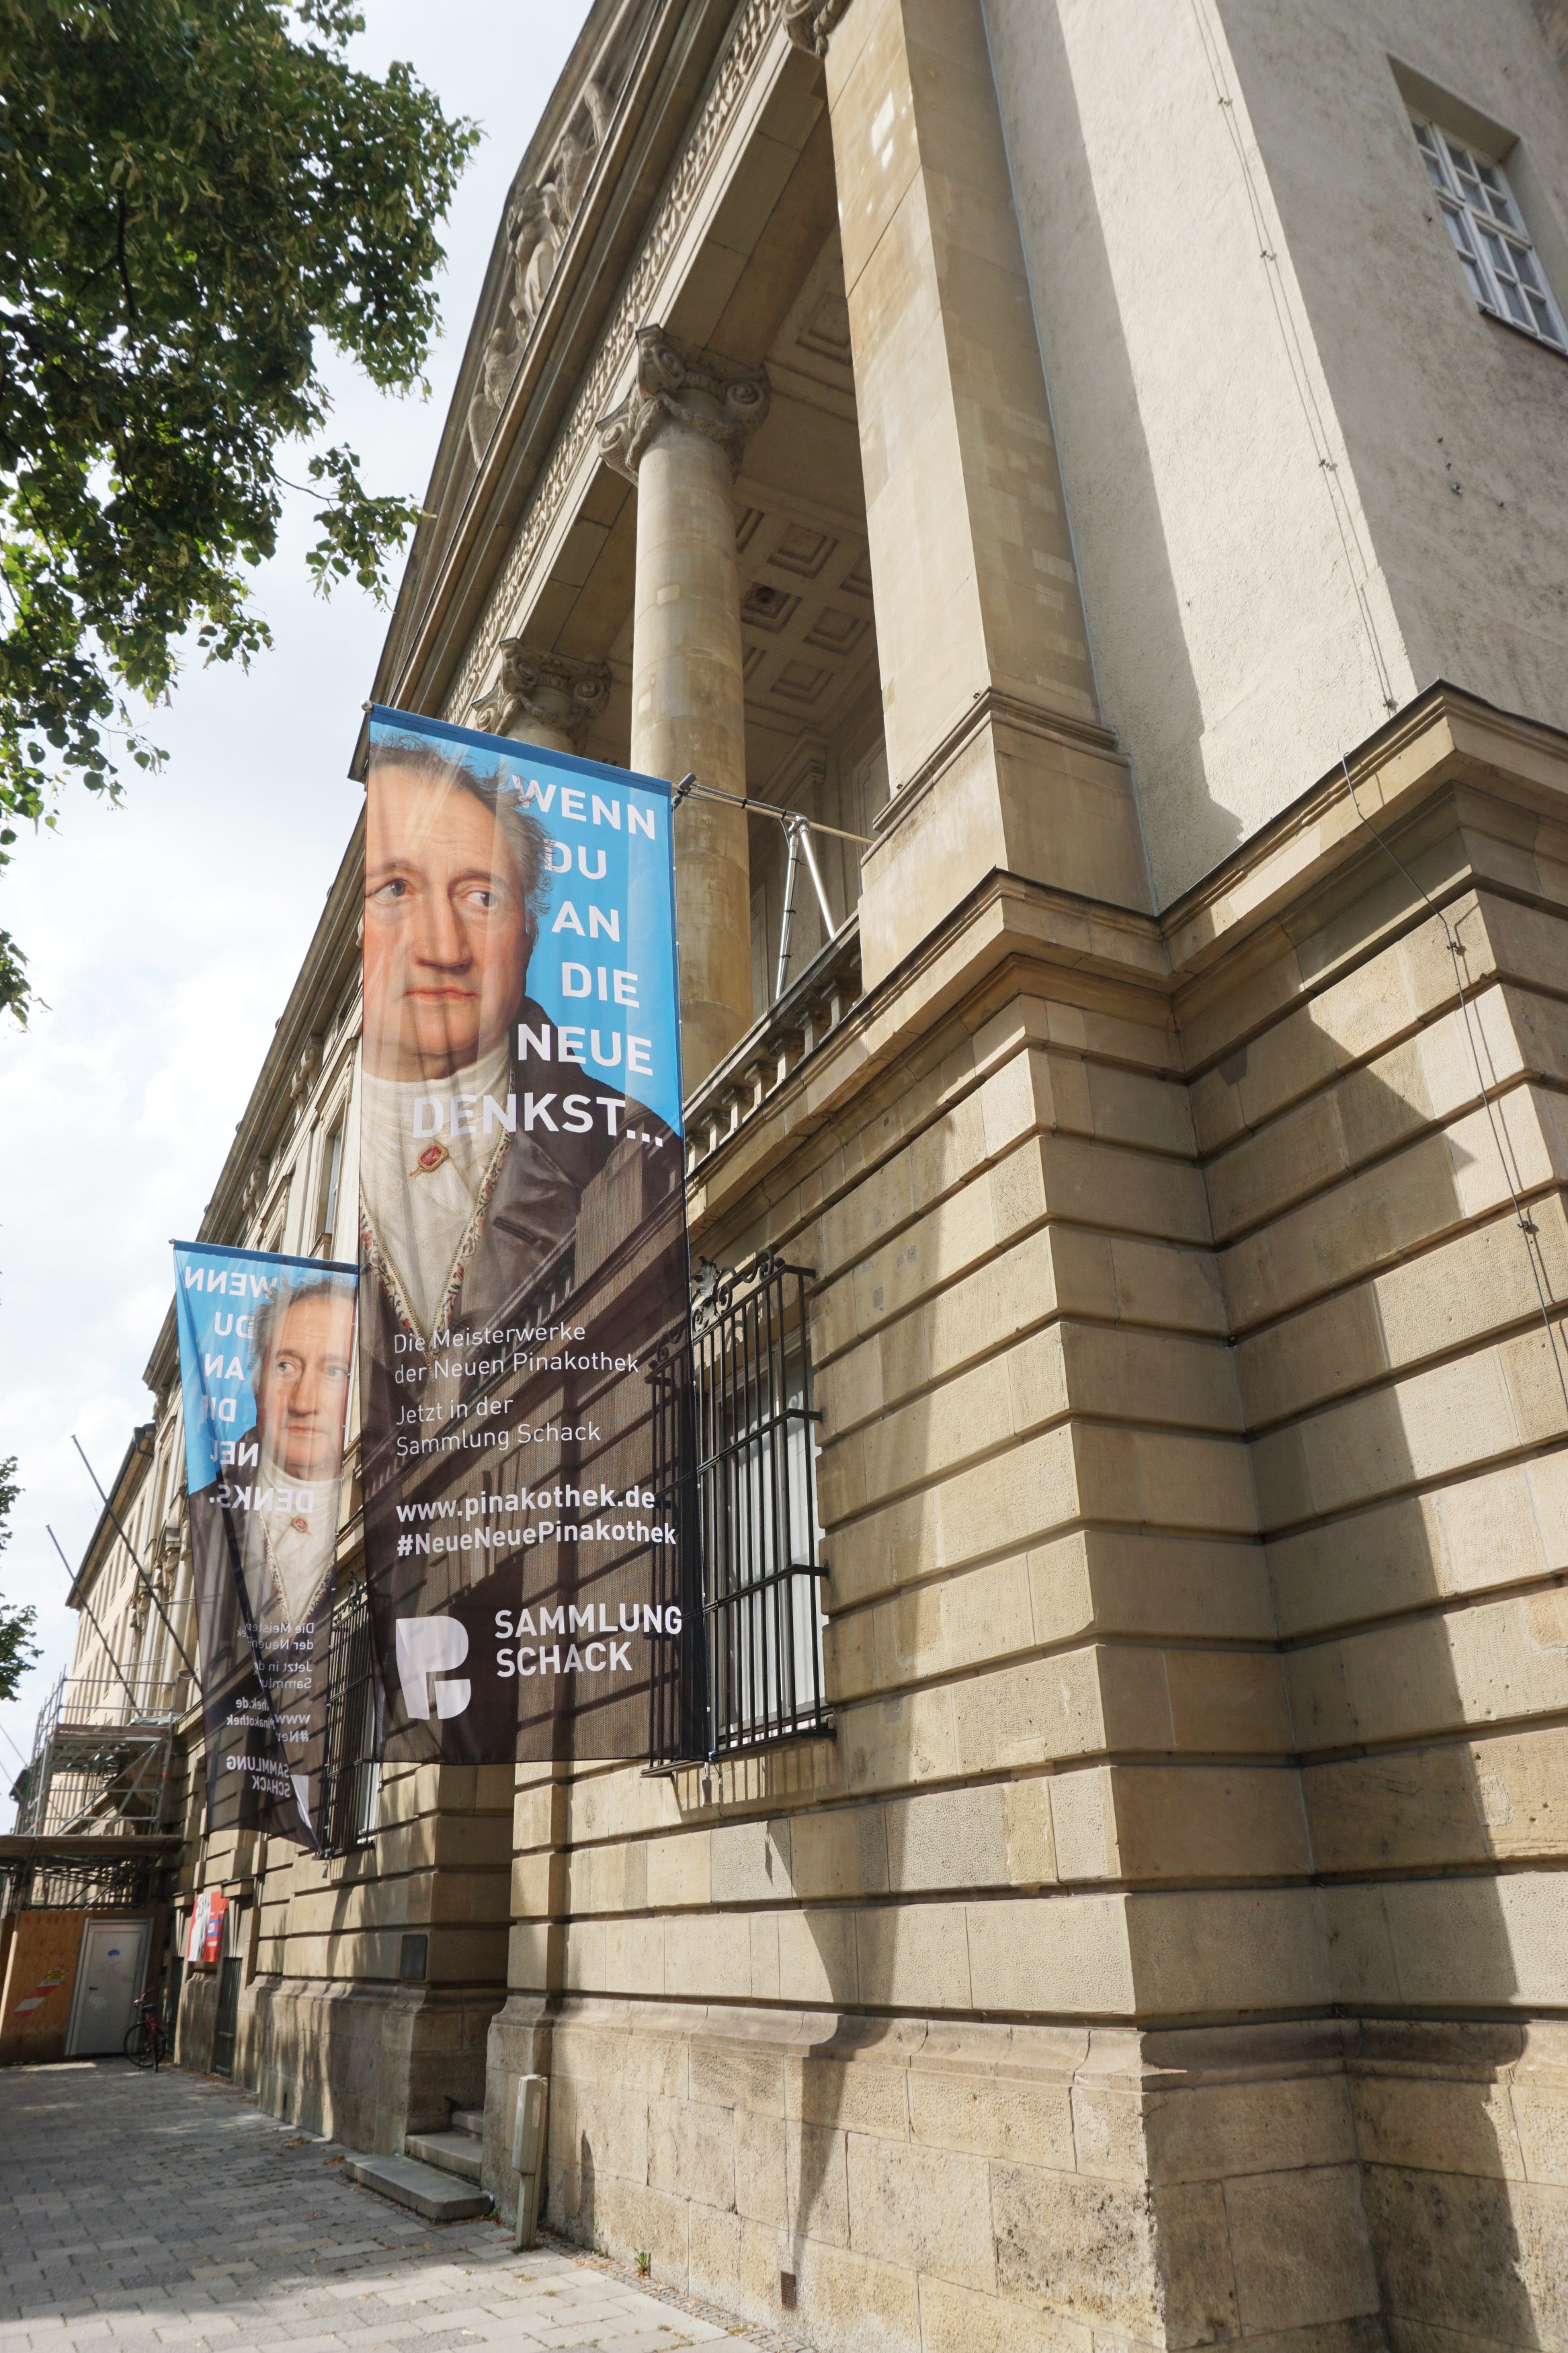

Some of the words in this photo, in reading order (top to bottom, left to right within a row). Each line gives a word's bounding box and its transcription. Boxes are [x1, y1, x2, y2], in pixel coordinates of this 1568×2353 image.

[513, 774, 656, 840] WENN
[544, 838, 608, 879] DU
[551, 901, 620, 943] AN
[562, 961, 640, 1008] DIE
[518, 1023, 654, 1076] NEUE
[413, 1092, 663, 1147] DENKST...
[395, 1332, 425, 1354] Die
[434, 1322, 586, 1349] Meisterwerke
[395, 1363, 427, 1384] der
[434, 1359, 505, 1380] Neuen
[513, 1351, 639, 1373] Pinakothek
[397, 1403, 442, 1425] Jetzt
[451, 1400, 468, 1419] in
[476, 1396, 513, 1417] der
[397, 1428, 509, 1456] Sammlung
[518, 1421, 601, 1443] Schack
[396, 1484, 655, 1523] www.pinakothek.de
[397, 1521, 676, 1556] #NeueNeuePinakothek
[495, 1603, 682, 1639] SAMMLUNG
[497, 1642, 633, 1677] SCHACK
